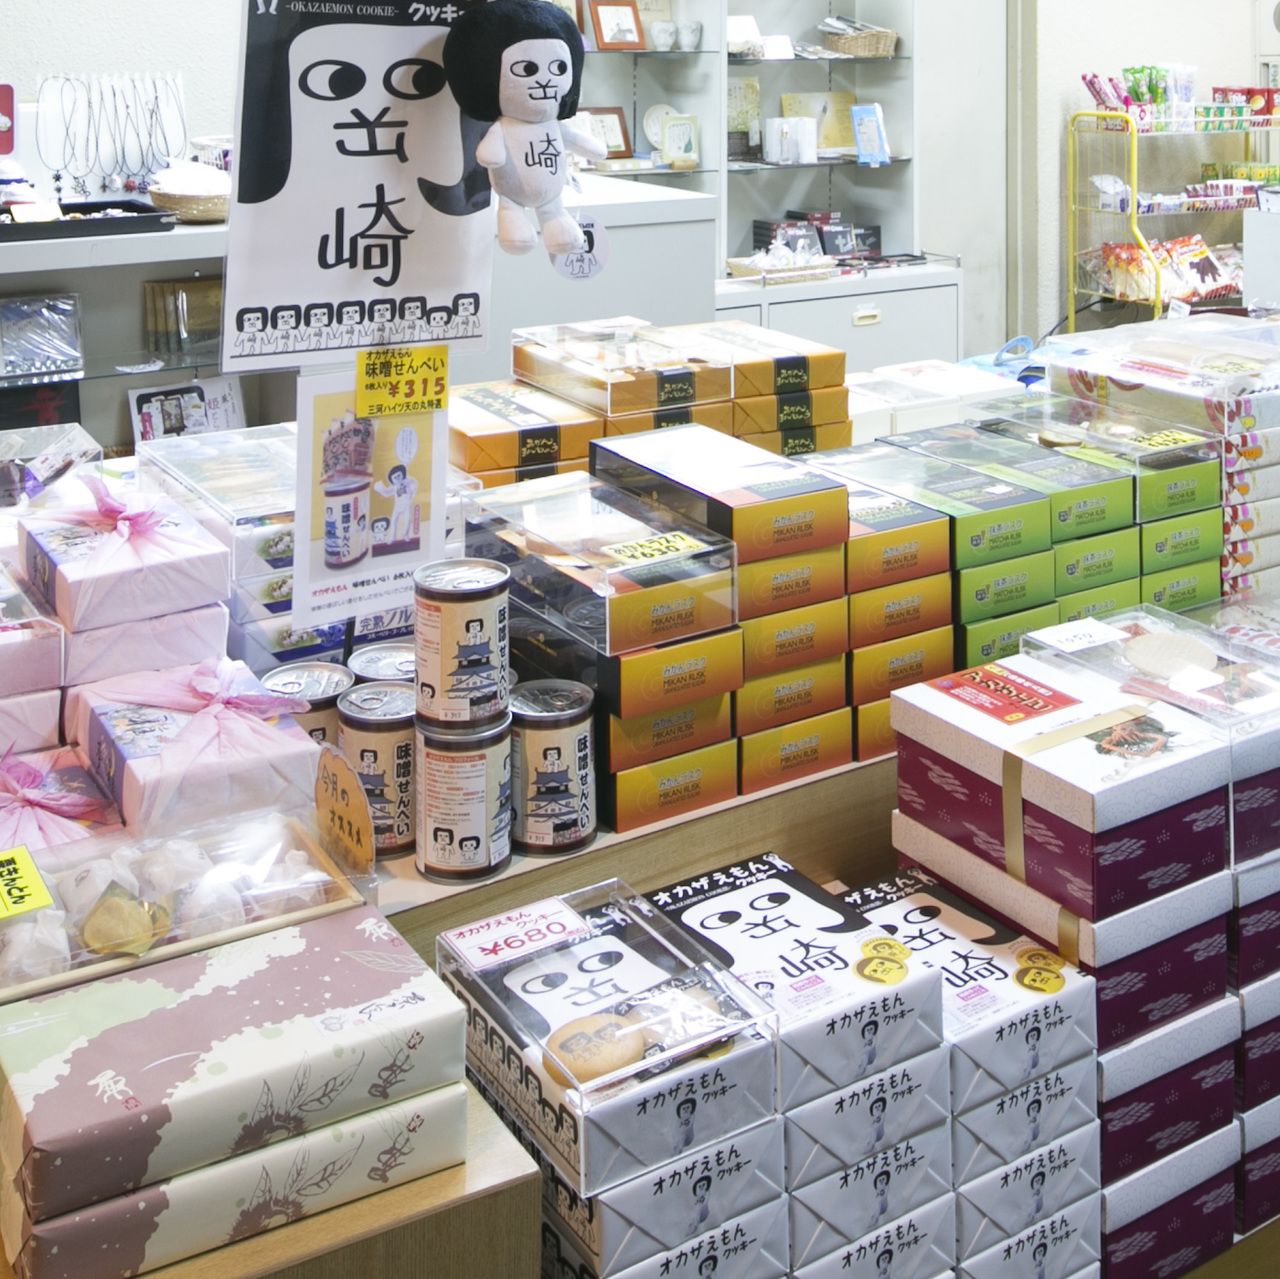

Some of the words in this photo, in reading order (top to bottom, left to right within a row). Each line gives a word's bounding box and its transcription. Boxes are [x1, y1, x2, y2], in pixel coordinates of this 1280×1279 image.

[317, 183, 415, 287] 崎
[365, 357, 445, 378] 味噌せんべい
[366, 348, 412, 362] オカザえもん
[388, 376, 446, 398] ¥315
[368, 398, 442, 414] 三河ハイツ天の丸特選
[496, 605, 509, 702] 味噌せんべい
[396, 740, 411, 837] 味噌せんべい
[576, 734, 591, 830] 味噌せんべい
[653, 860, 770, 906] オカザえもん
[735, 869, 778, 887] クッキー
[454, 911, 531, 939] オカザえもん
[478, 922, 566, 956] ¥680
[825, 992, 905, 1037] オカザえもん
[882, 1007, 915, 1027] クッキー
[995, 1000, 1064, 1043] オカザえもん
[1044, 1013, 1073, 1031] クッキー
[636, 1067, 728, 1117] オカザえもん
[701, 1083, 737, 1104] クッキー
[833, 1068, 914, 1116] オカザえもん
[892, 1083, 923, 1105] クッキー
[996, 1071, 1067, 1120] オカザえもん
[1045, 1084, 1074, 1108] クッキー
[652, 1142, 743, 1197] オカザえもん
[716, 1159, 753, 1182] クッキー
[838, 1140, 918, 1190] オカザえもん
[896, 1156, 928, 1179] クッキー
[1000, 1143, 1069, 1188] オカザえもん
[1047, 1157, 1077, 1179] クッキー
[659, 1222, 748, 1278] オカザえもん
[721, 1239, 756, 1261] クッキー
[841, 1218, 920, 1268] オカザえもん
[896, 1233, 929, 1255] クッキー
[1001, 1217, 1069, 1262] オカザえもん
[1048, 1232, 1081, 1251] クッキー
